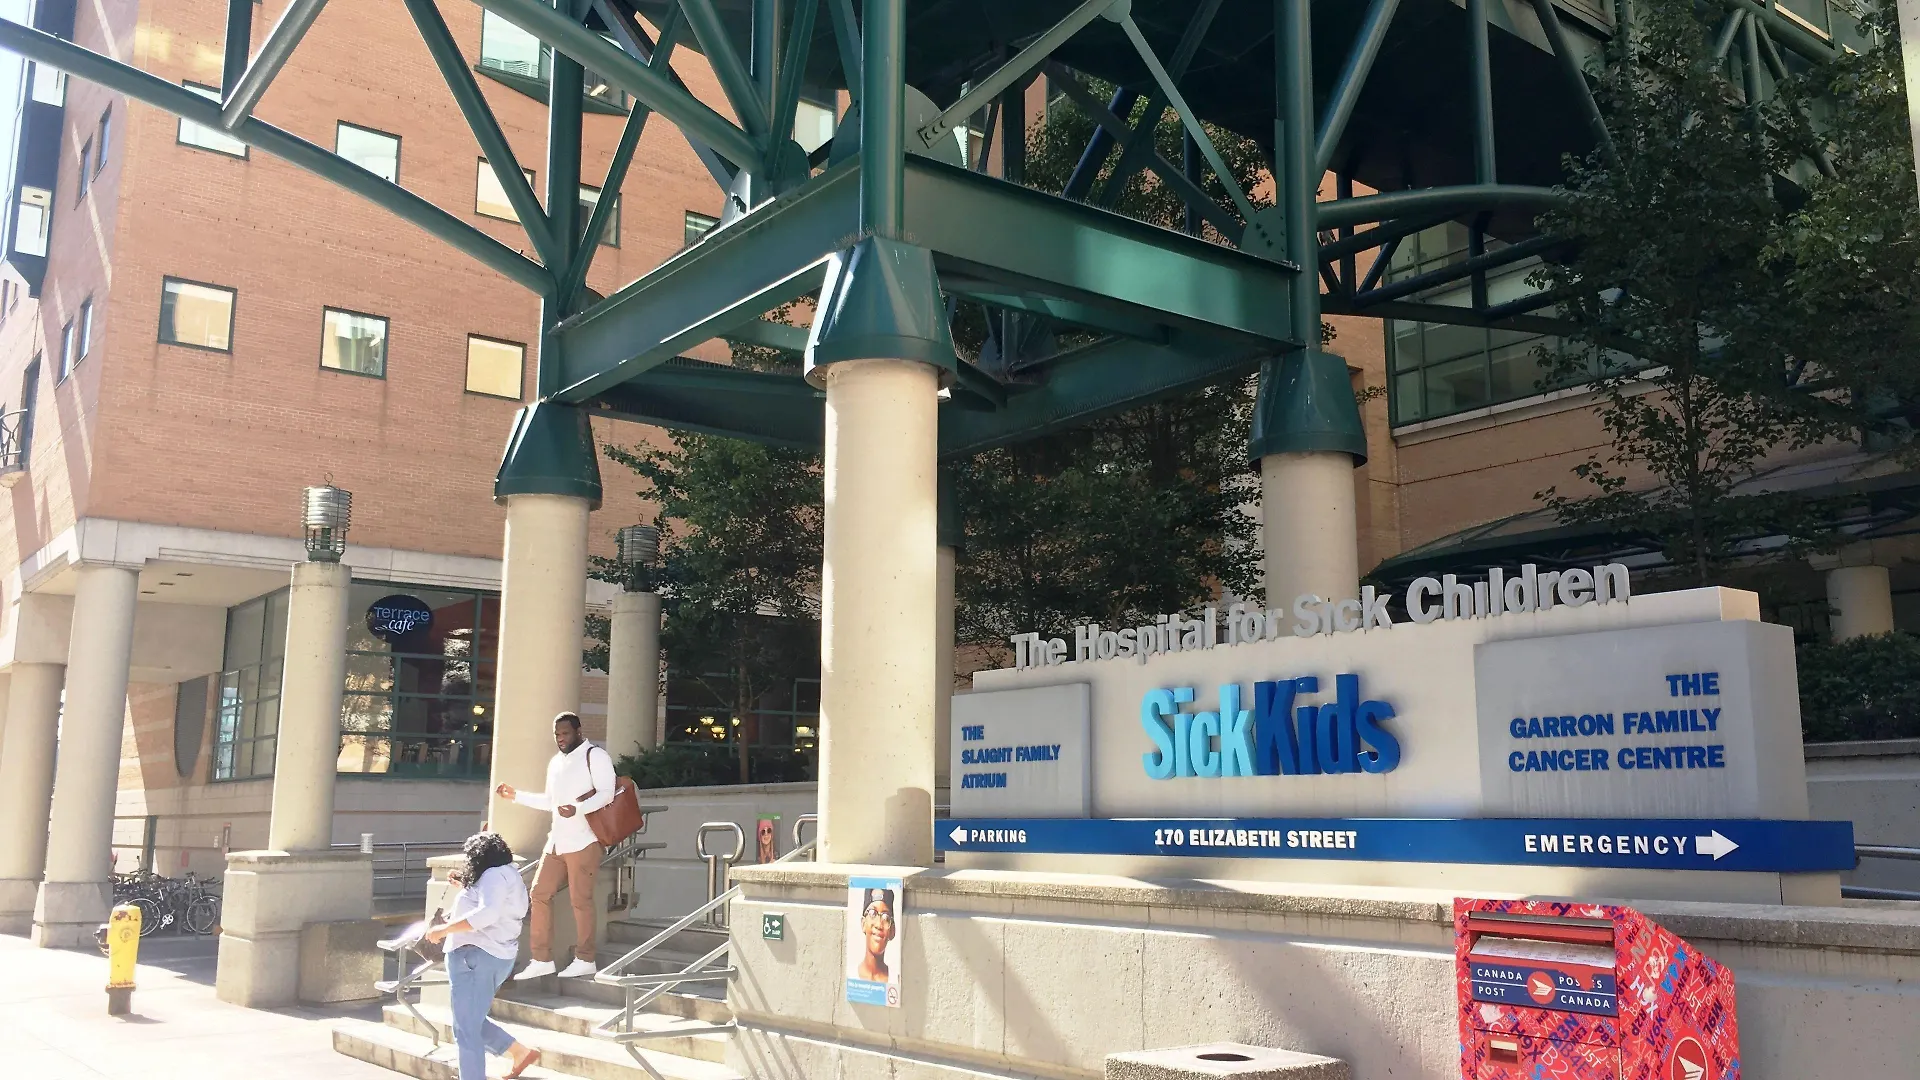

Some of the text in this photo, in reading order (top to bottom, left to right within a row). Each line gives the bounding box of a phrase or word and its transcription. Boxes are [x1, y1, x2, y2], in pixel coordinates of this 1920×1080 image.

[374, 606, 430, 621] Terrace
[1011, 562, 1631, 671] The Hospital for Sick Children
[1666, 672, 1720, 697] THE
[961, 725, 984, 741] THE
[1140, 673, 1401, 780] SickKids
[1509, 708, 1721, 739] GARRON FAMILY
[961, 744, 1061, 764] SLAIGHT FAMILY
[1508, 744, 1725, 772] CANCER CENTRE
[961, 772, 1007, 789] ATRIUM
[971, 829, 1027, 844] PARKING
[1154, 828, 1357, 849] 170 ELIZABETH STREET
[1524, 833, 1688, 855] EMERGENCY
[1477, 968, 1523, 981] CANADA
[1478, 986, 1505, 997] POST
[1560, 995, 1610, 1009] CANADA
